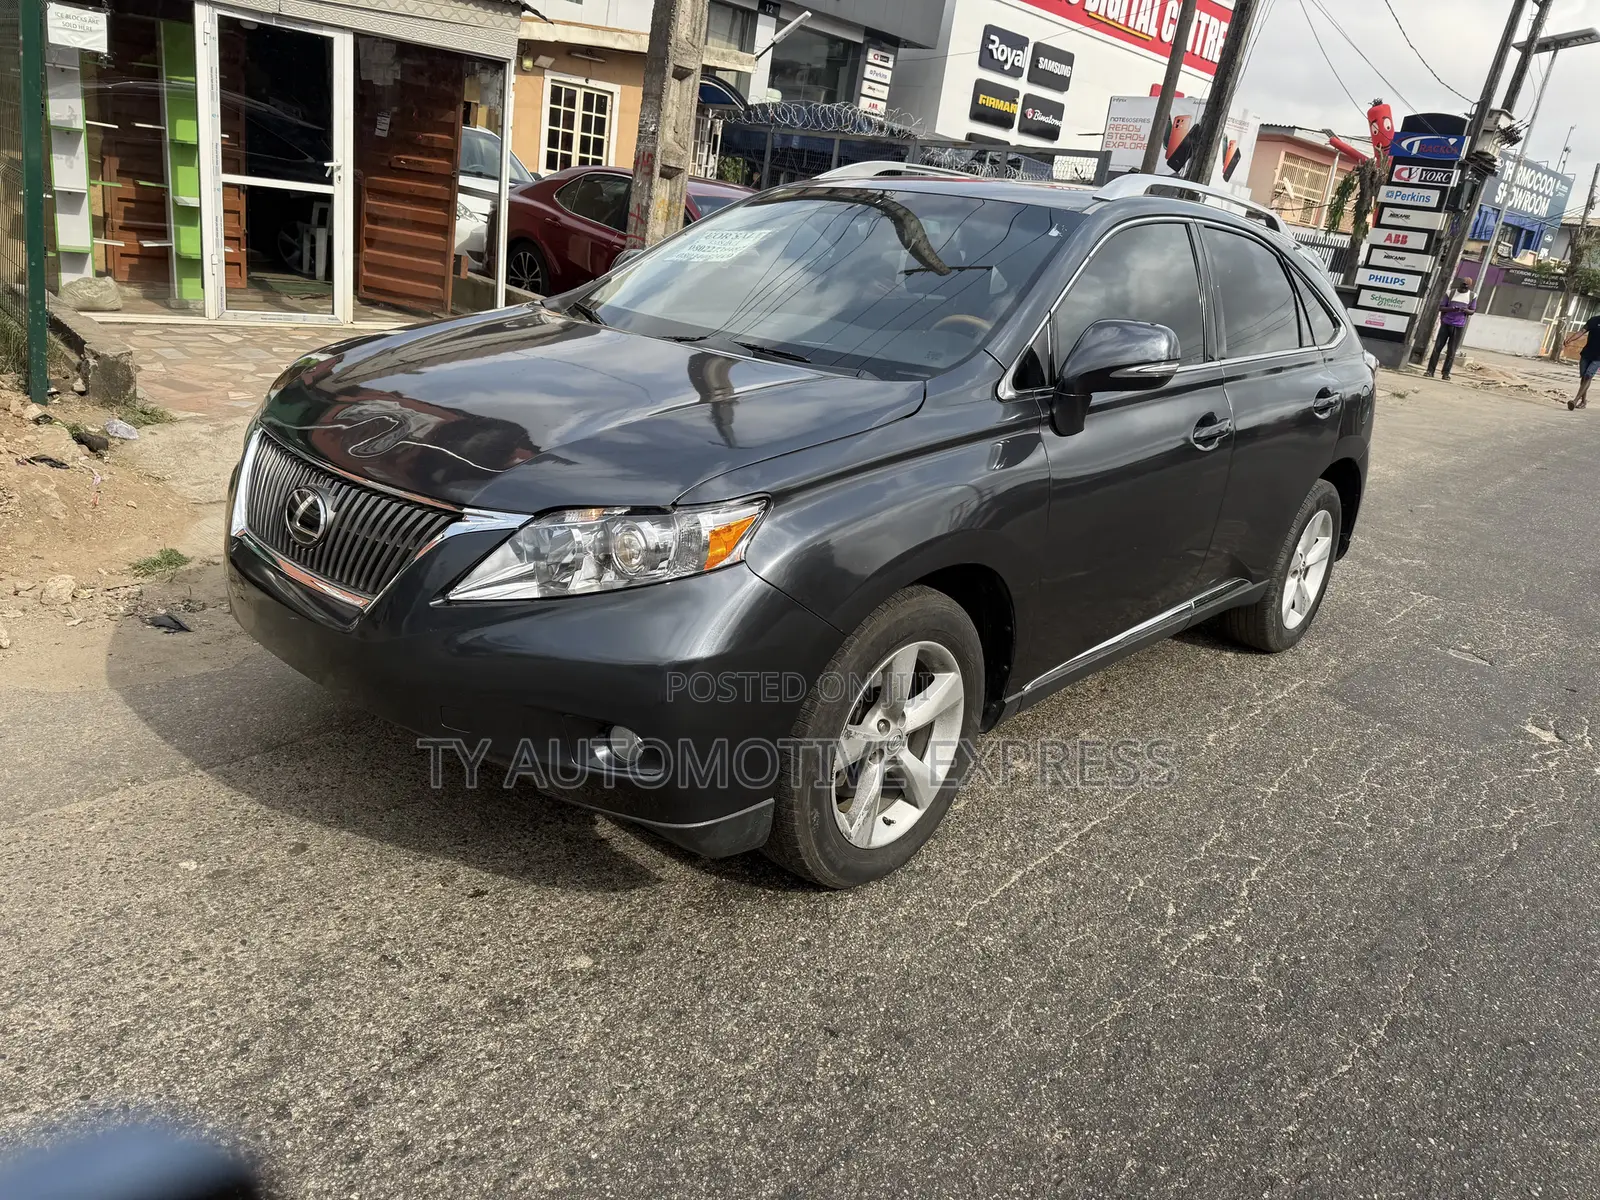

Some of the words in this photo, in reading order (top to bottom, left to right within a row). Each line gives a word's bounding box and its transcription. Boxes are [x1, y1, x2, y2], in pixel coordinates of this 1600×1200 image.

[65, 13, 88, 22] BLOCKS
[62, 21, 78, 29] SOLD
[1083, 0, 1161, 38] DIGITAL
[1160, 0, 1228, 64] CTRE
[988, 34, 1028, 71] Royal
[1038, 56, 1072, 78] SAMSUNG
[1108, 124, 1142, 133] READY
[1107, 132, 1146, 142] STEADY
[1420, 170, 1453, 183] YORC
[1503, 161, 1556, 197] THRMOCOOL
[1394, 190, 1431, 203] Perkins
[1383, 232, 1409, 245] ABB
[1368, 273, 1406, 287] PHILIPS
[1370, 293, 1405, 305] Schneider
